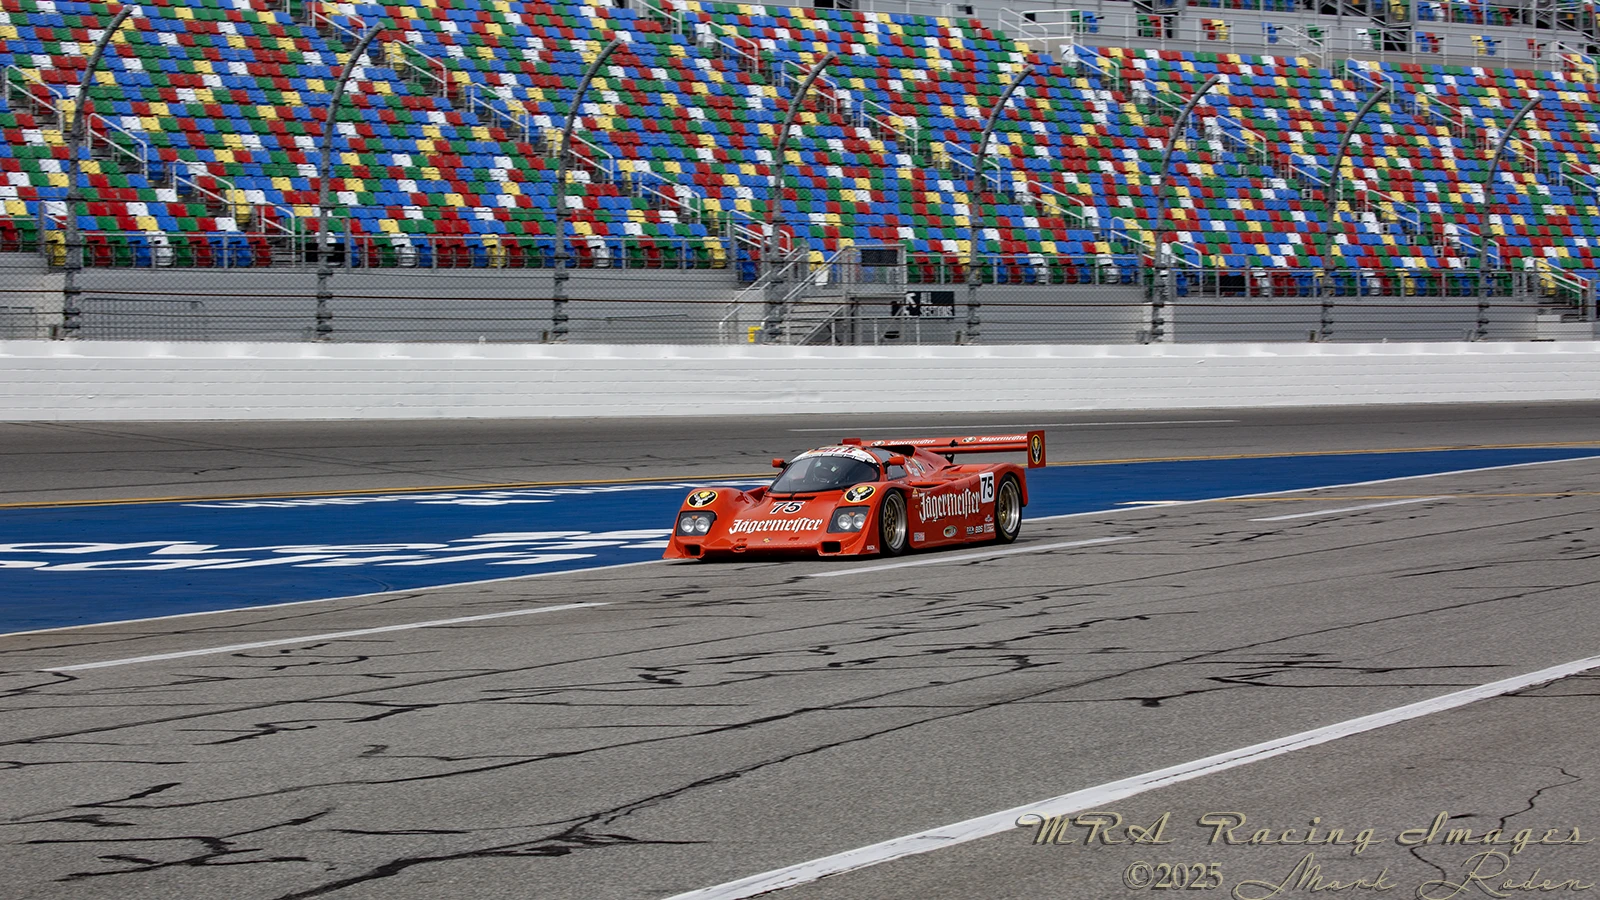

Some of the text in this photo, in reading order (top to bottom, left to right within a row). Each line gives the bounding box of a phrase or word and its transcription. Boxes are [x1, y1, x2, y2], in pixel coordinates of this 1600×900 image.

[981, 476, 994, 499] 75
[769, 501, 805, 515] 75
[919, 488, 980, 523] Jägermeister
[729, 517, 824, 534] Jägermeister
